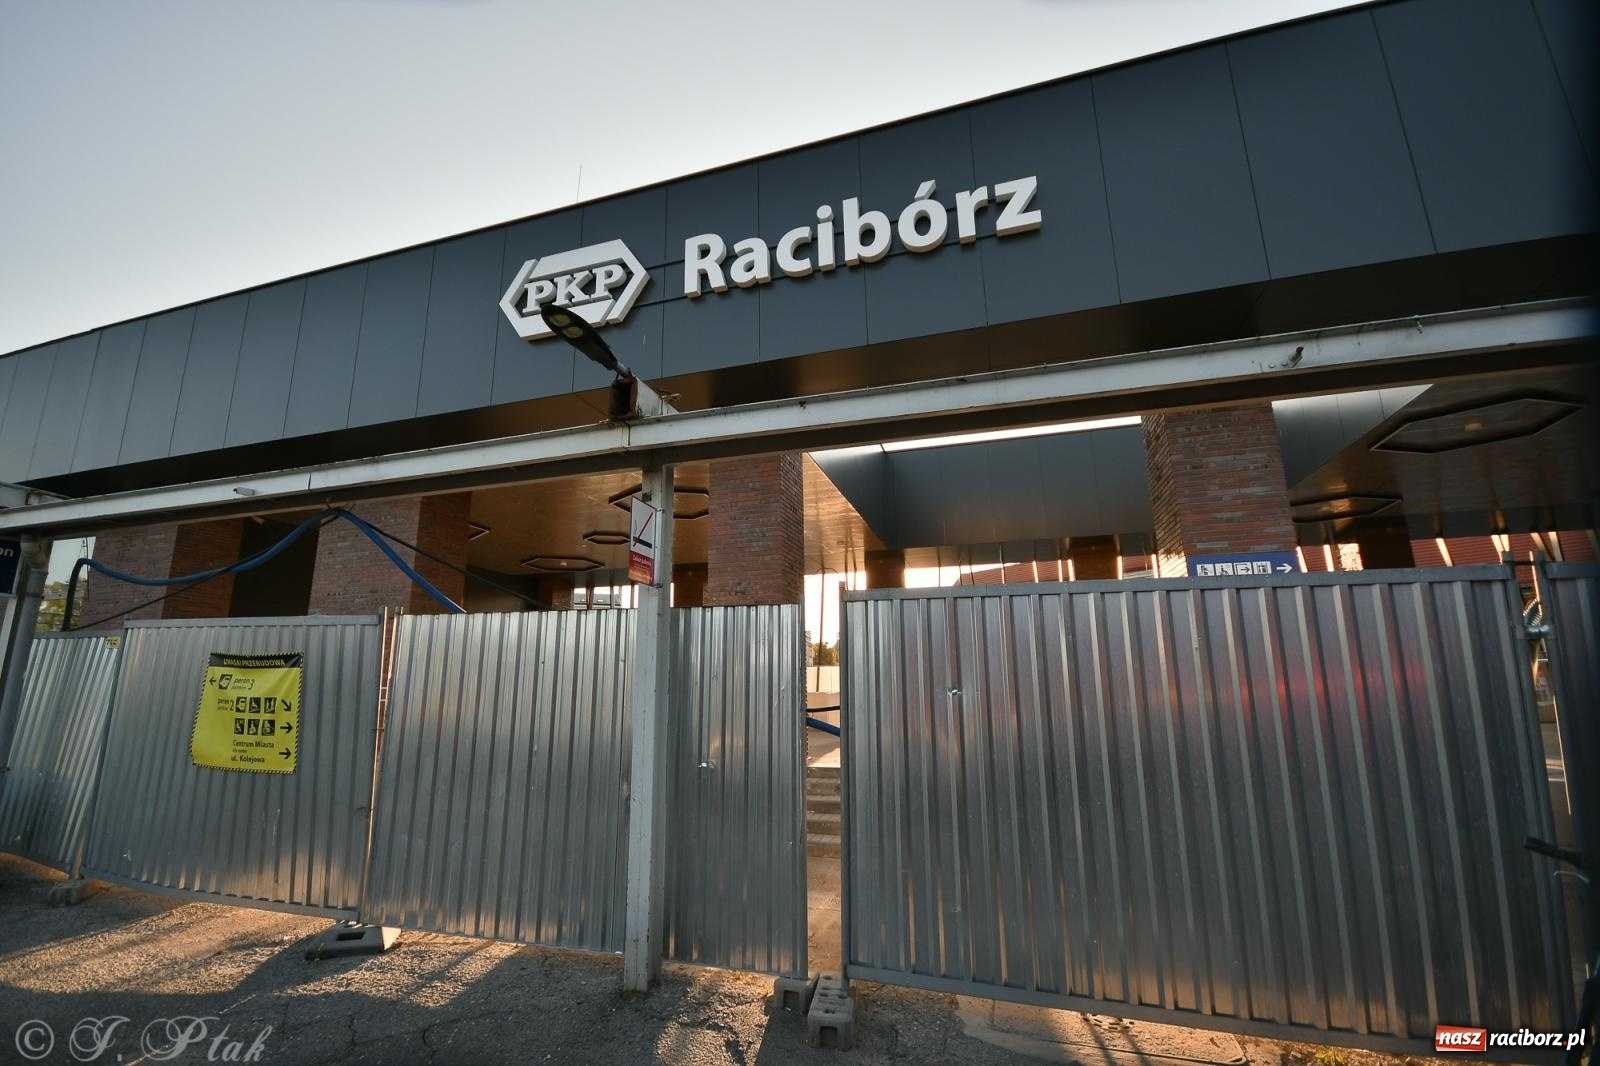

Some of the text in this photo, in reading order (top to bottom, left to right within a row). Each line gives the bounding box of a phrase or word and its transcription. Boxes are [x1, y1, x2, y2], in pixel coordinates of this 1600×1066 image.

[684, 176, 1042, 297] Racibórz
[521, 263, 627, 316] PKP
[242, 658, 285, 667] PRZEBUDOWA
[248, 678, 255, 690] 3
[229, 699, 234, 711] 2
[232, 740, 274, 748] Centrum Miasta
[239, 755, 265, 764] Kolejowa
